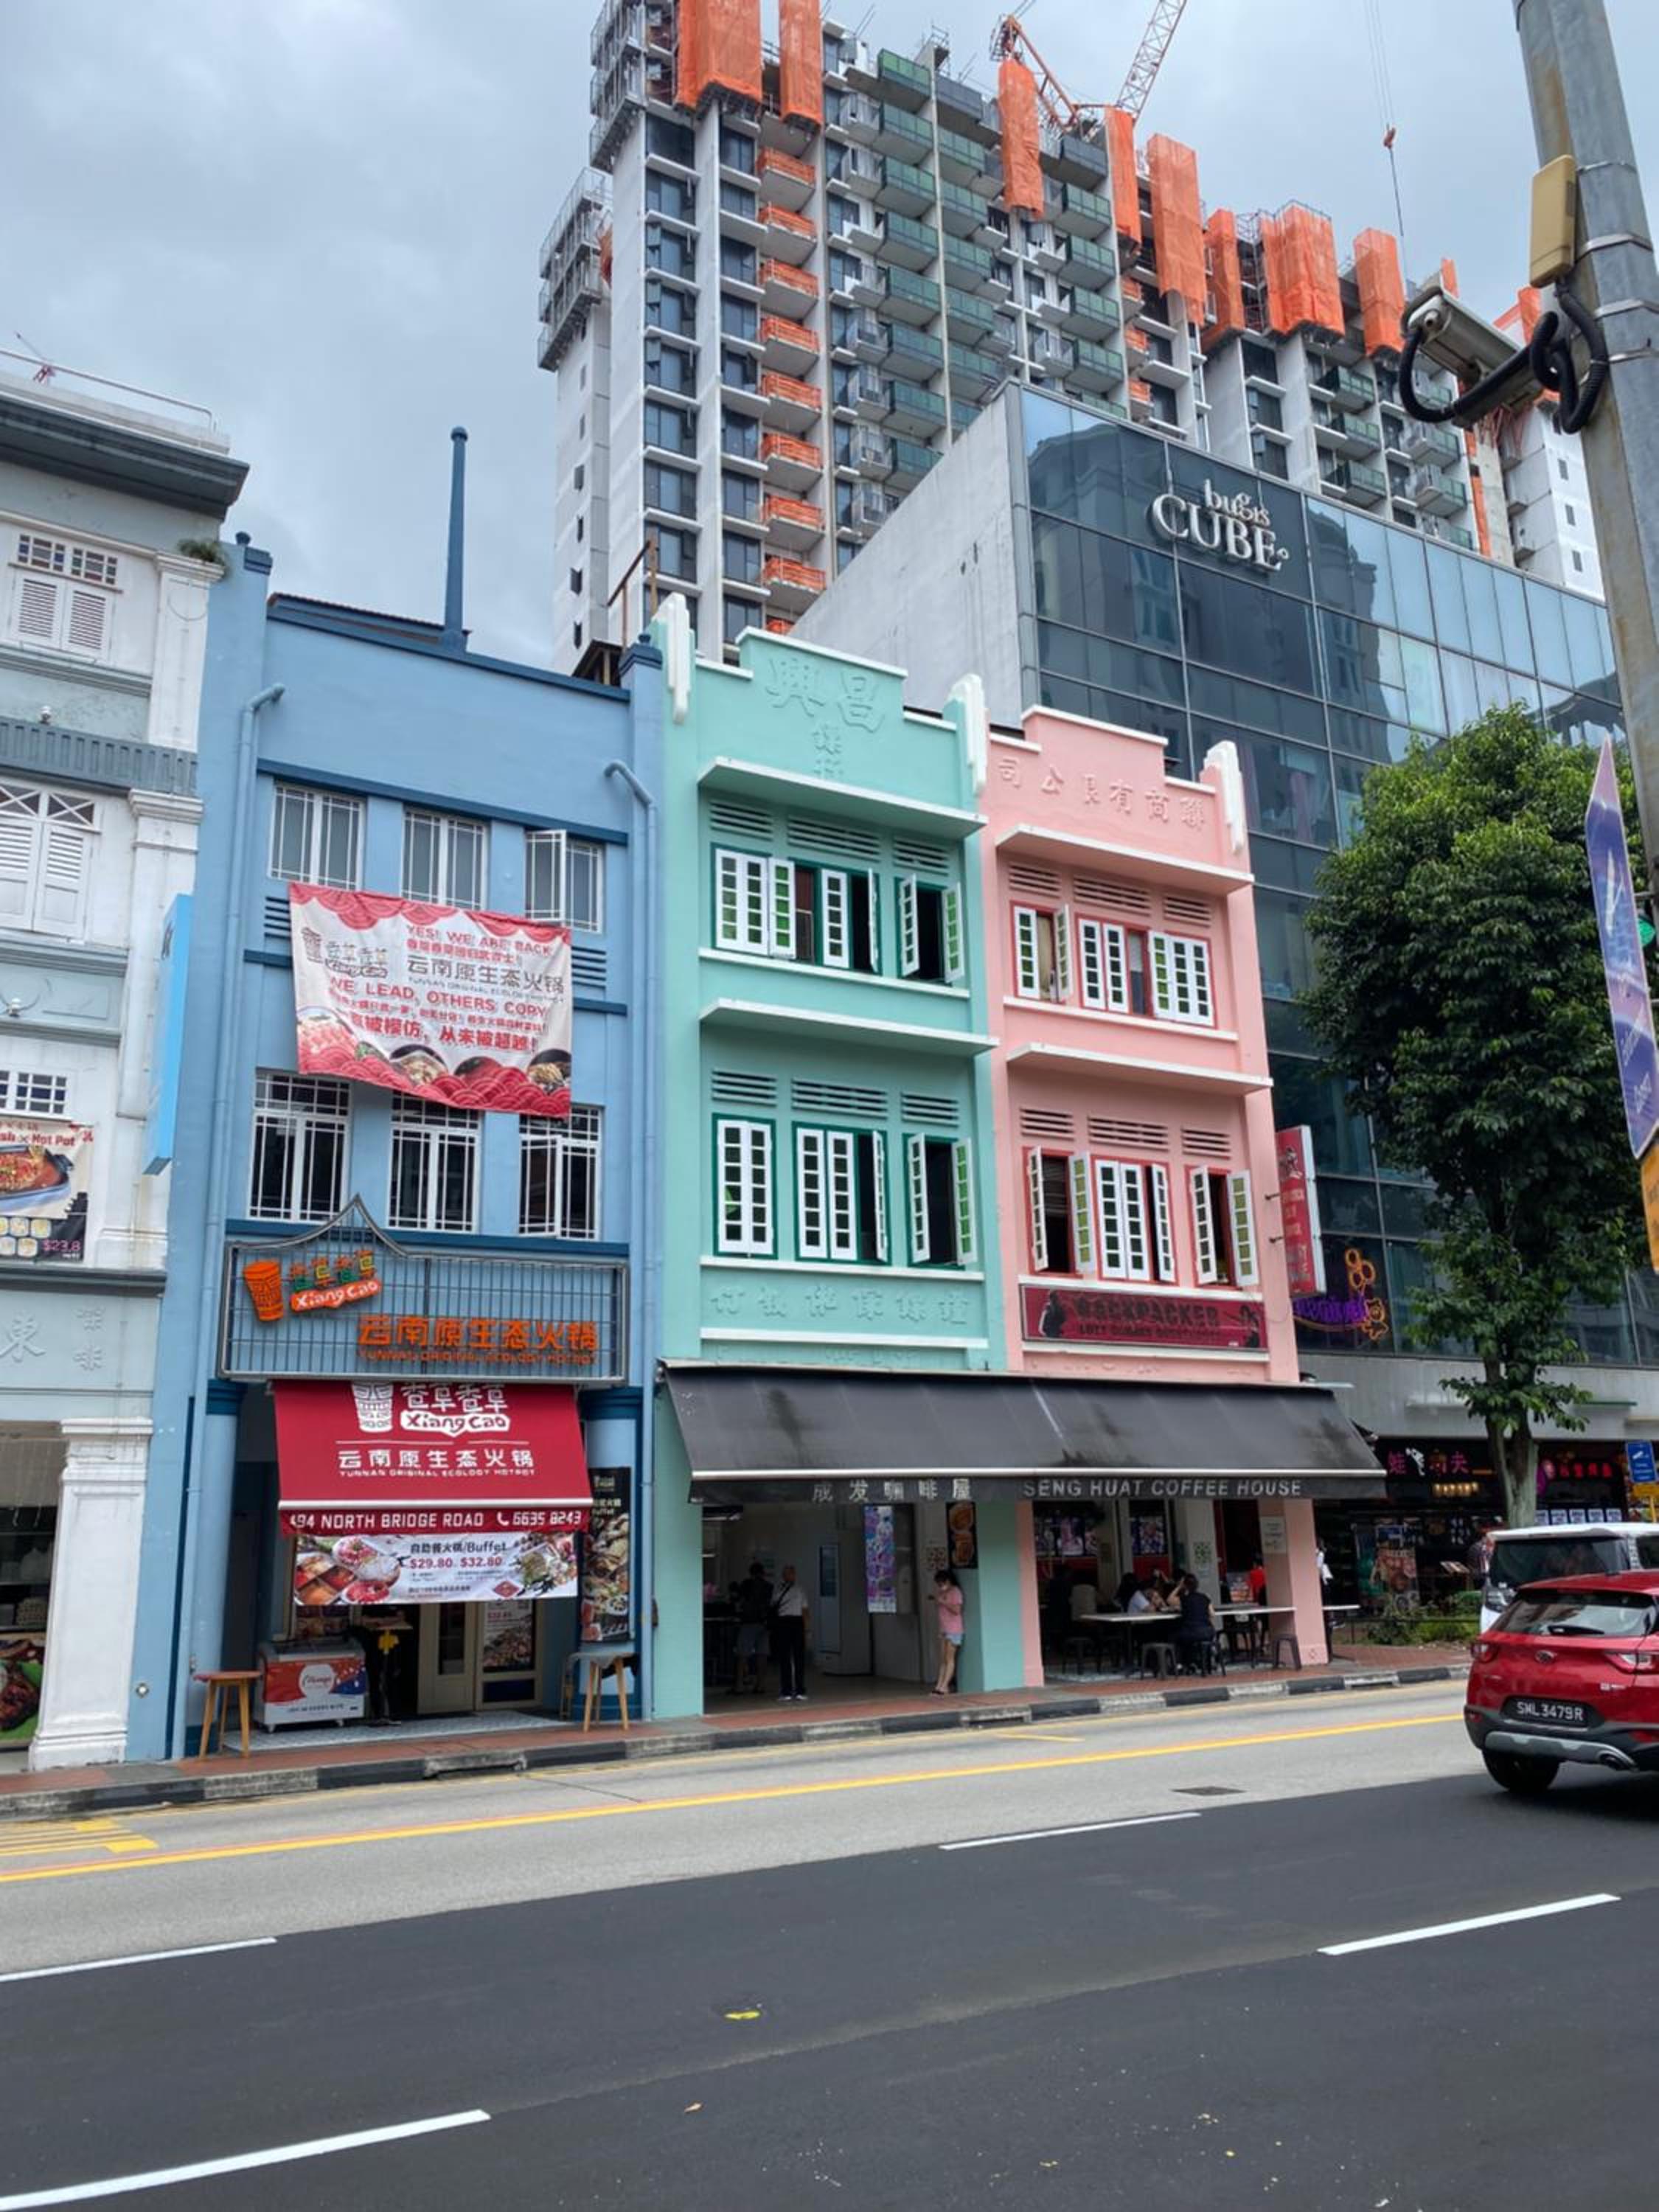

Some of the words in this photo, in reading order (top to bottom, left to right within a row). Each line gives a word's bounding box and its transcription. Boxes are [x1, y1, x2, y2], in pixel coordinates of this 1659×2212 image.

[1152, 493, 1282, 571] CUBE
[406, 925, 439, 939] YES!
[447, 931, 473, 945] WE
[480, 937, 507, 950] ARE
[515, 941, 552, 956] BACK
[426, 990, 495, 1012] OTHERS
[504, 1001, 546, 1018] COPY
[358, 1314, 597, 1349] 云南原生态火锅
[338, 1448, 535, 1469] 云南原生态火锅
[1023, 1478, 1082, 1498] SENG
[1090, 1478, 1144, 1498] HUAT
[1150, 1478, 1229, 1497] COFFEE
[1237, 1479, 1302, 1497] HOUSE
[321, 1513, 375, 1529] NORTH
[380, 1513, 437, 1528] BRIDGE
[442, 1512, 484, 1528] ROAD
[512, 1511, 546, 1526] 6635
[549, 1510, 582, 1525] 8243
